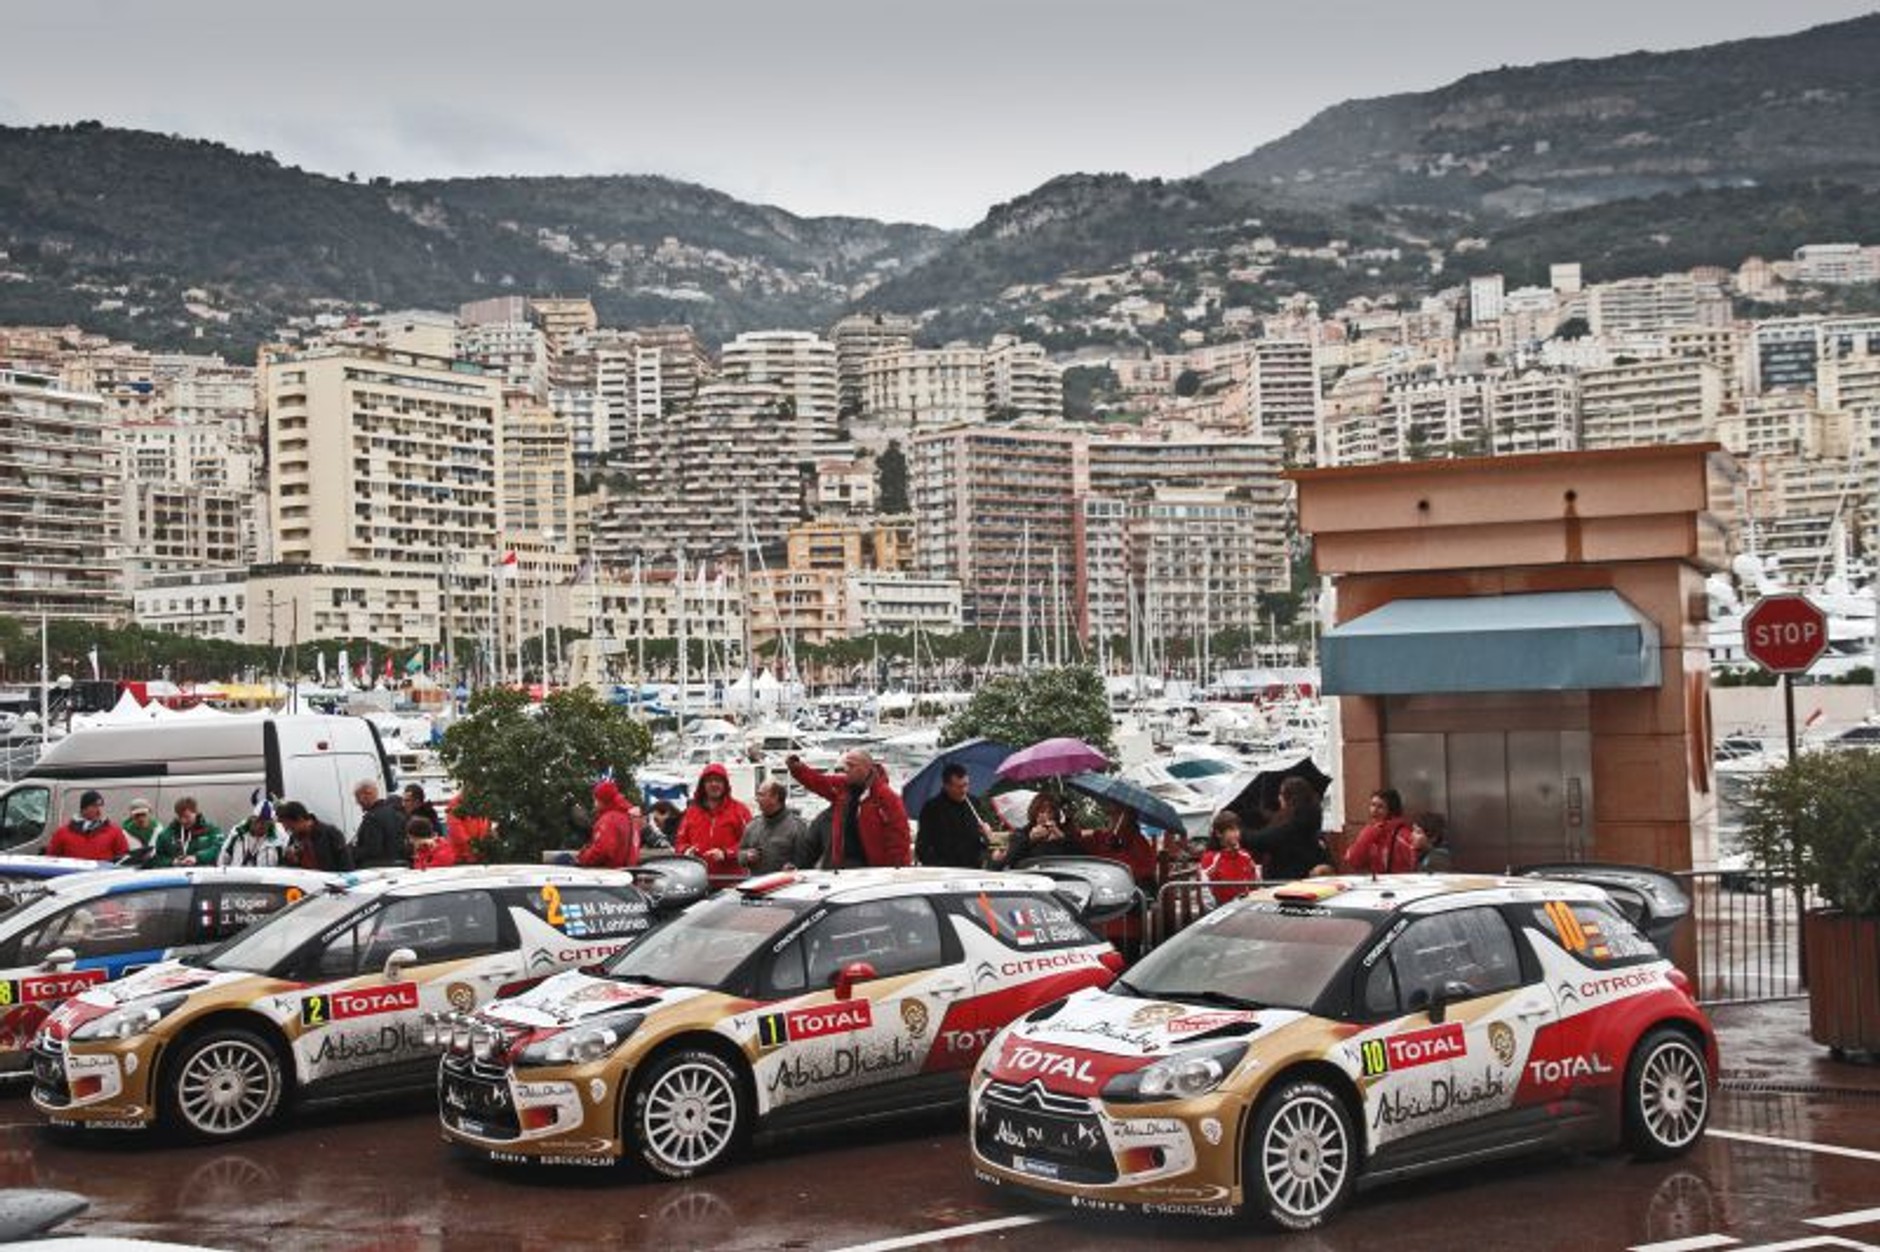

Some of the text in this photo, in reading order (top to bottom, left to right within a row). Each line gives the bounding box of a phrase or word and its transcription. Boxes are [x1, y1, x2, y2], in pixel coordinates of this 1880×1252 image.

[1755, 622, 1818, 646] STOP
[540, 884, 565, 925] 2
[1544, 900, 1587, 951] 10
[309, 997, 323, 1025] 2
[336, 991, 414, 1014] TOTAL
[766, 1014, 777, 1046] 1
[792, 1009, 867, 1033] TOTAL
[1362, 1040, 1386, 1075] 10
[1391, 1036, 1462, 1061] TOTAL
[1006, 1047, 1097, 1083] TOTAL
[1529, 1052, 1613, 1083] TOTAL
